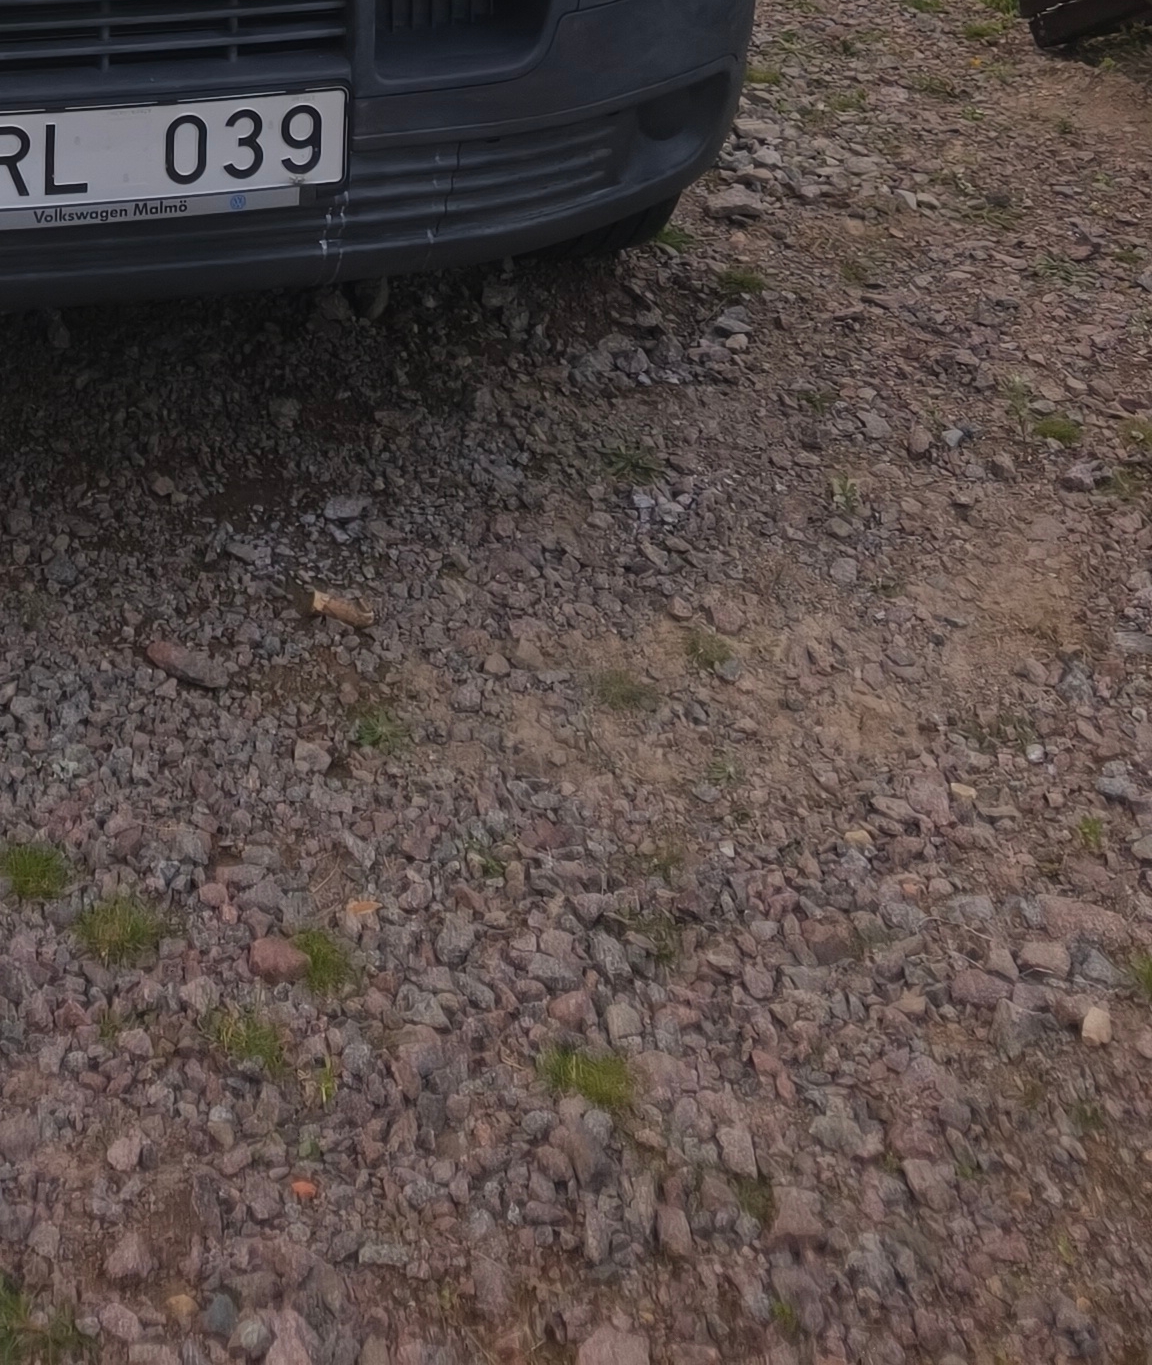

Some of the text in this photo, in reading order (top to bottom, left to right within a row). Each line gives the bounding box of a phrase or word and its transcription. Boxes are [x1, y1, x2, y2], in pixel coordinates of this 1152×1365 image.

[165, 104, 322, 185] 039
[33, 199, 188, 224] Volkswagen Malmö
